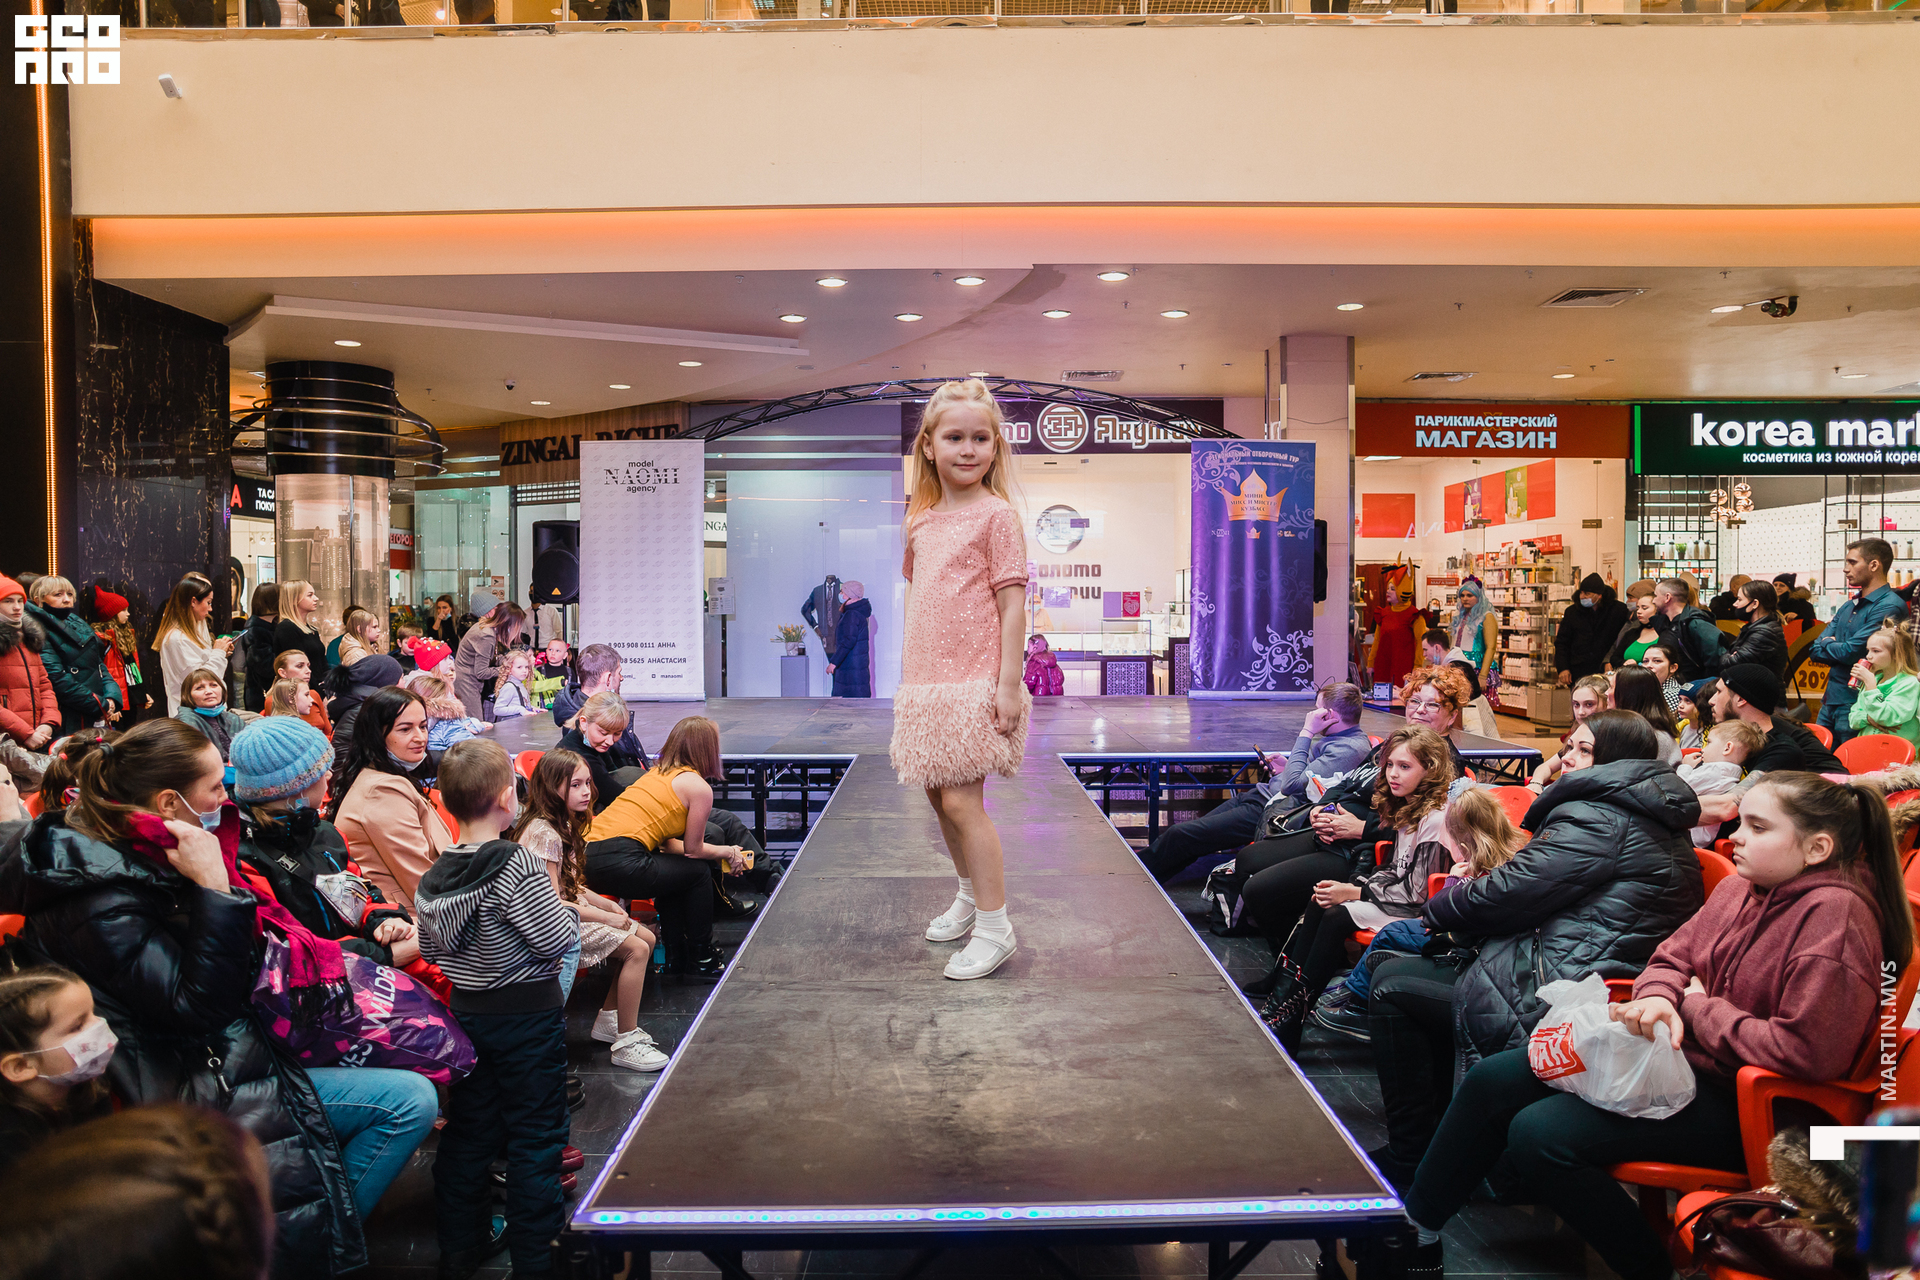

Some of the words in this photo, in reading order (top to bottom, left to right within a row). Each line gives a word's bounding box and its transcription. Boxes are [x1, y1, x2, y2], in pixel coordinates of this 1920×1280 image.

[1415, 413, 1558, 428] ПАРИКМАСТЕРСКИЙ
[1692, 412, 1816, 446] korea
[1827, 411, 1920, 446] mar
[1415, 430, 1557, 449] МАГАЗИН
[628, 460, 654, 468] model
[1289, 455, 1300, 463] ТУР
[1743, 453, 1813, 463] косметика
[1816, 453, 1832, 463] из
[1835, 450, 1882, 463] южной
[1885, 452, 1920, 466] коре
[604, 468, 680, 485] NAOMI
[626, 485, 657, 493] agency
